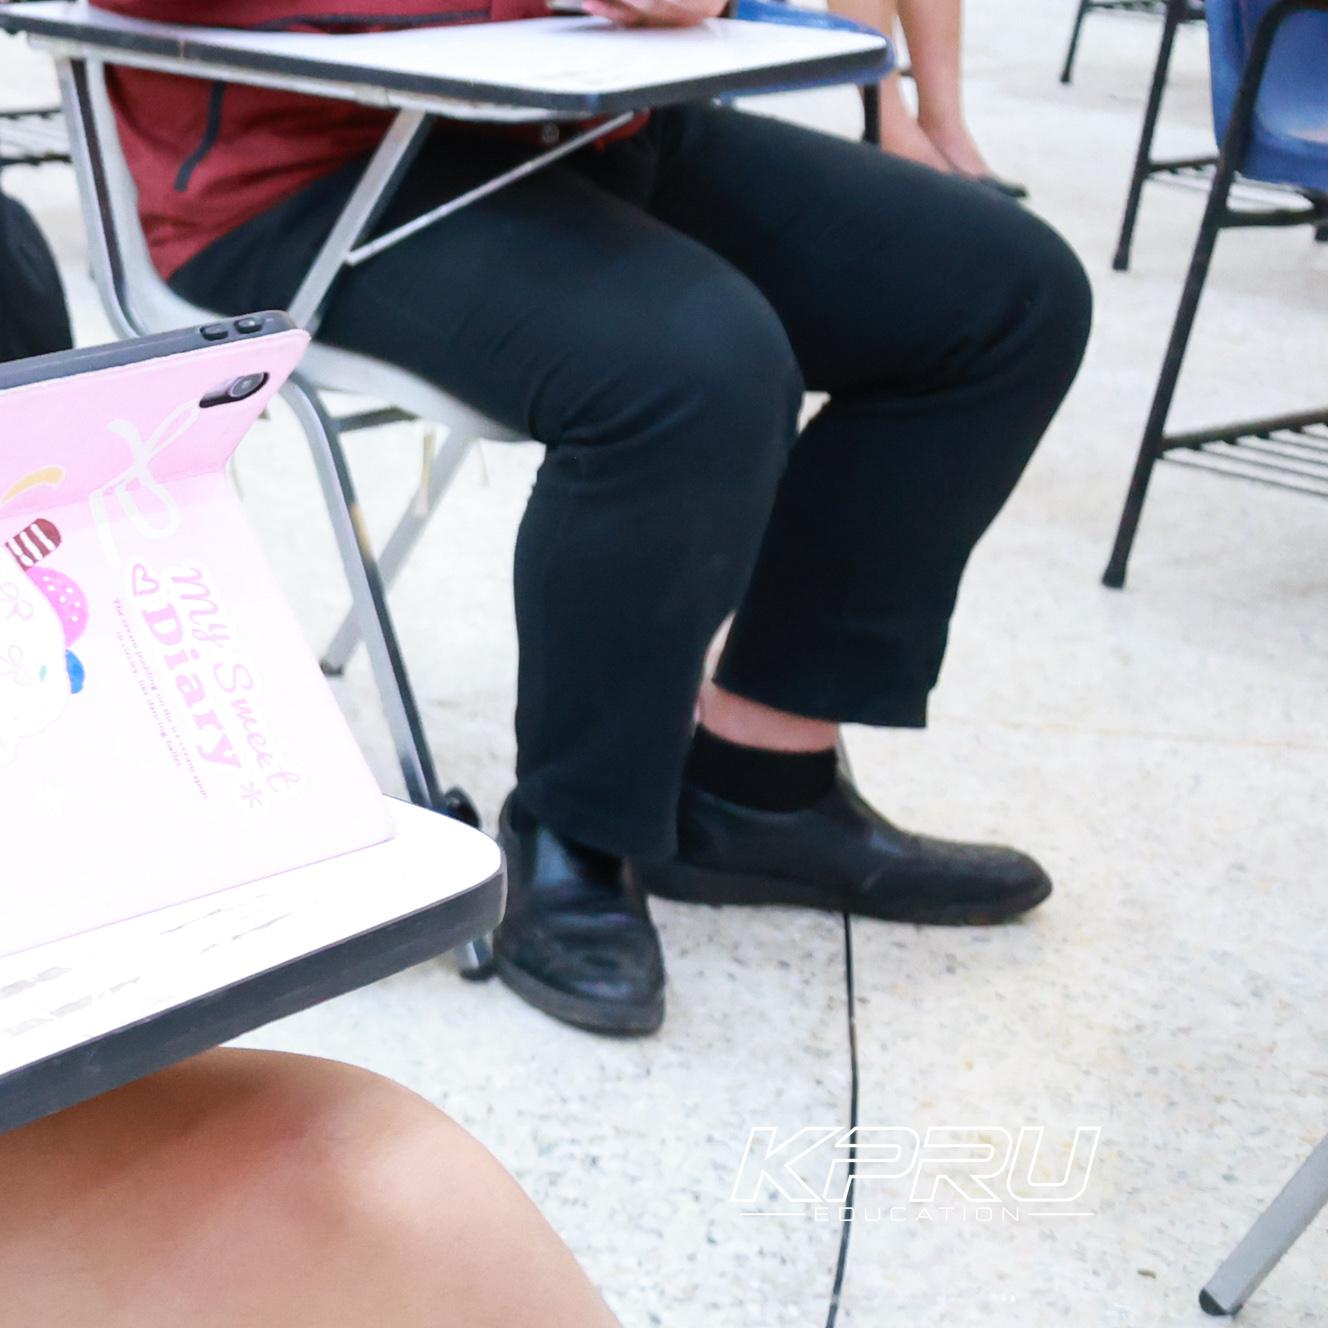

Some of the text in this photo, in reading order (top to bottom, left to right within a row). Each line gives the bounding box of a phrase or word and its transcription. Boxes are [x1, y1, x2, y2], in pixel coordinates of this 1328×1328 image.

[142, 603, 242, 768] Diary
[171, 567, 301, 793] My Sweet
